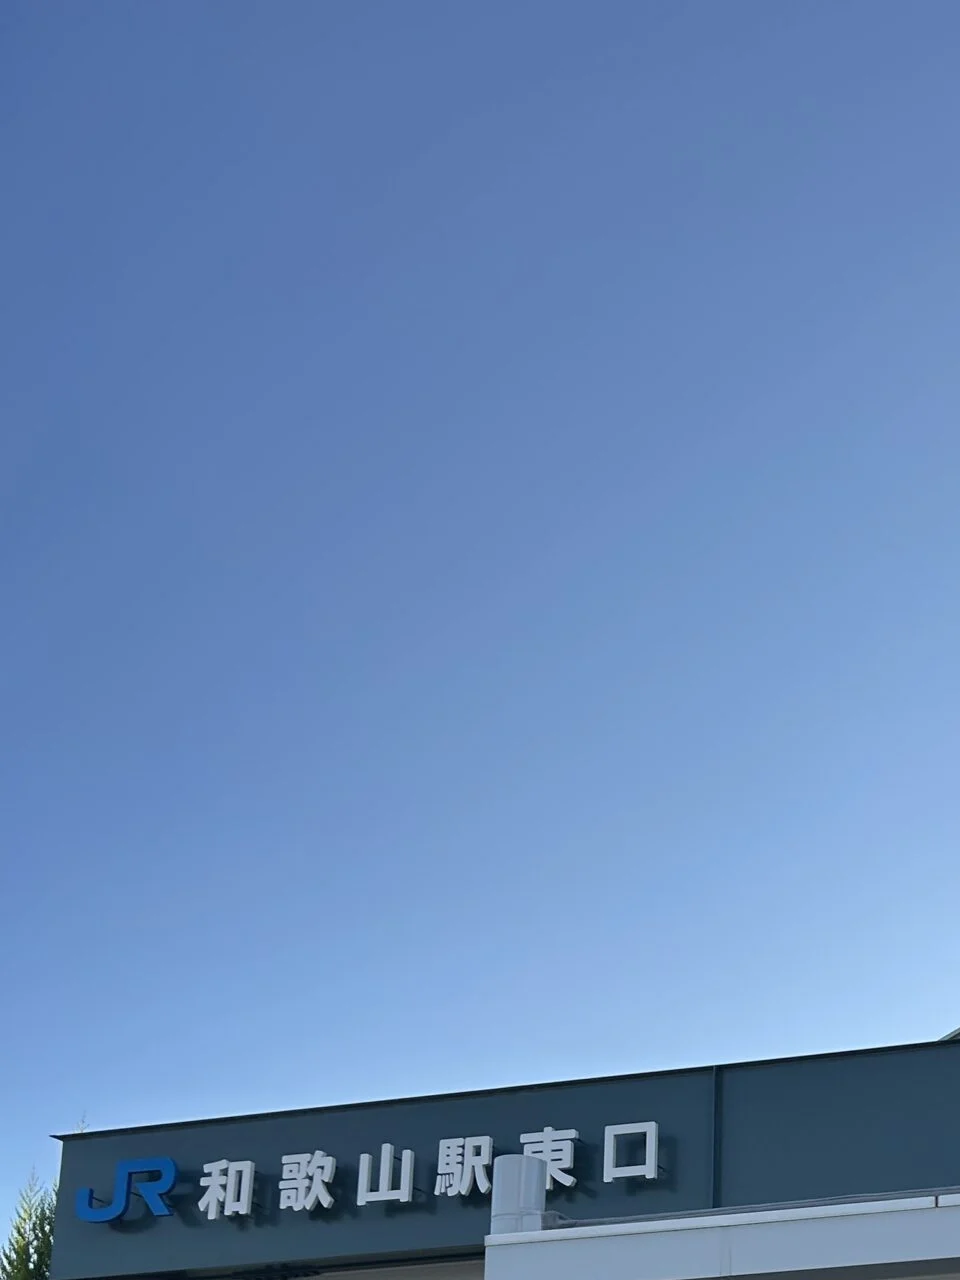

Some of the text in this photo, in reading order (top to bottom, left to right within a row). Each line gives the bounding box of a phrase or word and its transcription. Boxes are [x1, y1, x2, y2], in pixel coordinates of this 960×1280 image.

[75, 1120, 660, 1225] JR 和歌山駅東口
